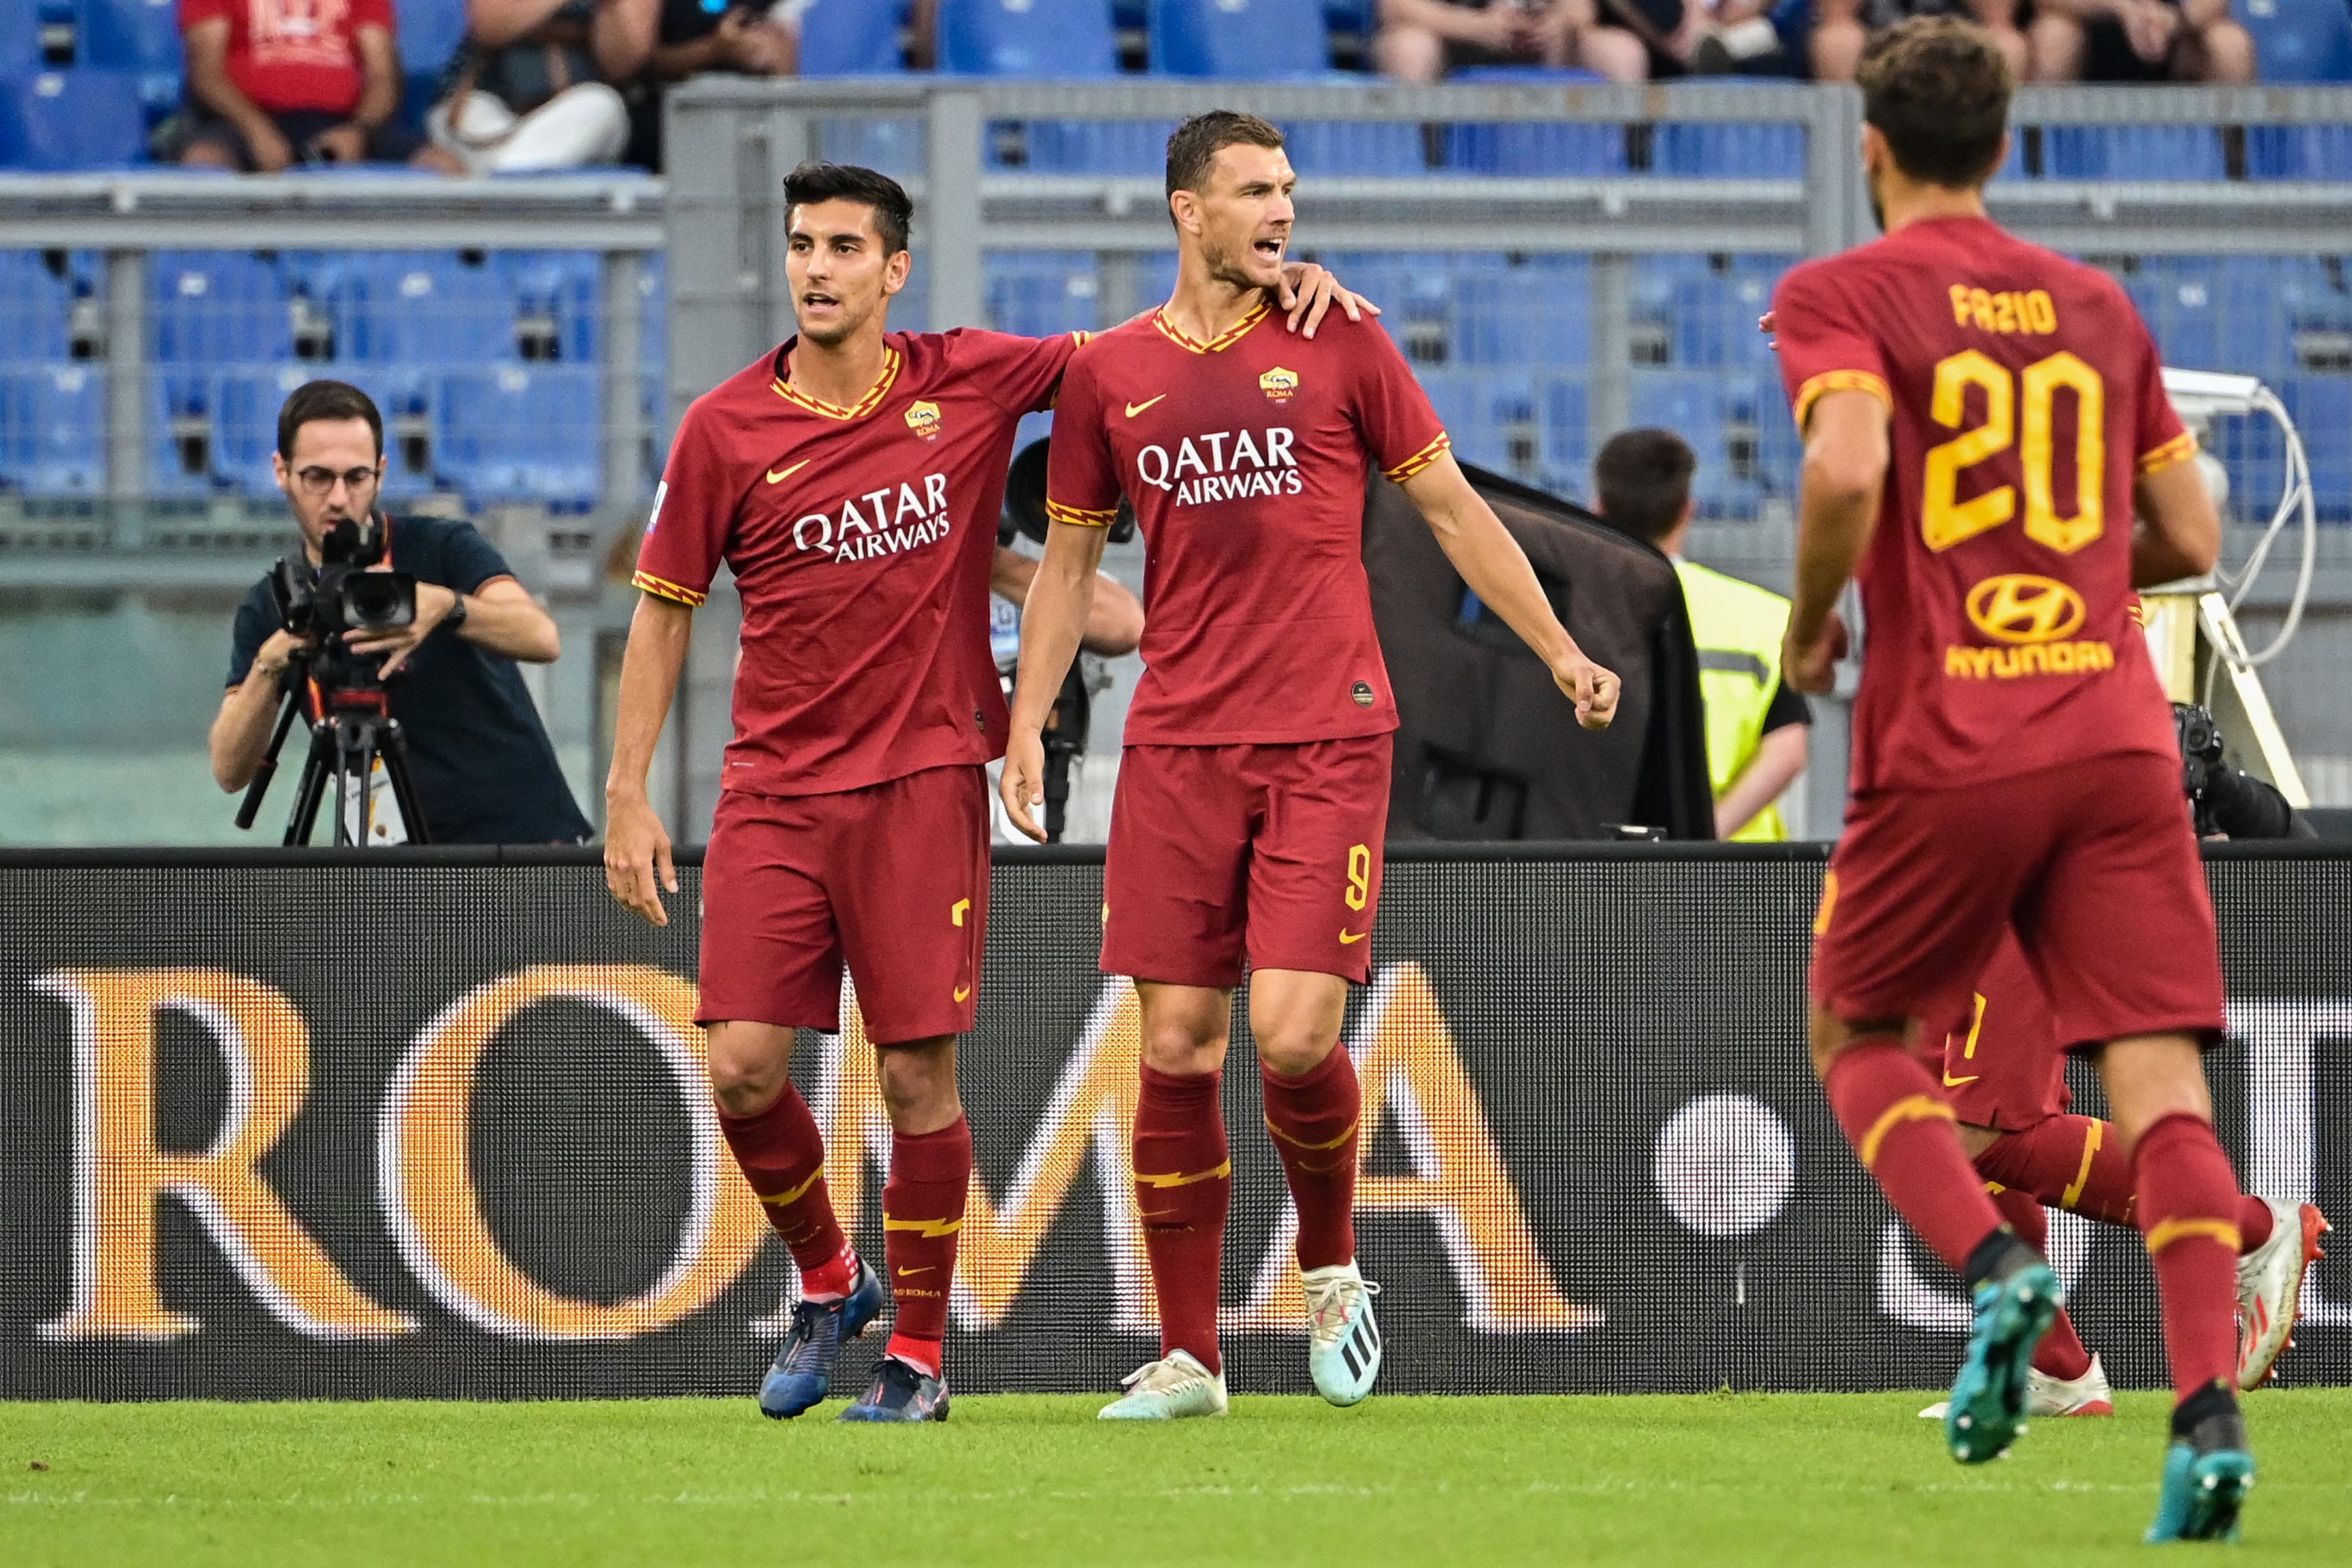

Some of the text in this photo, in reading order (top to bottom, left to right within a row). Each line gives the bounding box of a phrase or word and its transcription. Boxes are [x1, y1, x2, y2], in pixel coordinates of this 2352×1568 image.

[1948, 284, 2057, 336] FAZIO
[1267, 389, 1294, 398] ROMA
[916, 423, 940, 437] ROMA
[1921, 348, 2104, 554] 20
[1137, 427, 1298, 491] QATAR
[792, 473, 947, 554] QATAR
[1176, 469, 1302, 507] AIRWAYS
[835, 511, 950, 564] AIRWAYS
[1944, 640, 2115, 678] HYUNDAI
[1345, 843, 1370, 911] 9
[31, 960, 1606, 1339] ROMA
[893, 1288, 941, 1298] AS ROMA
